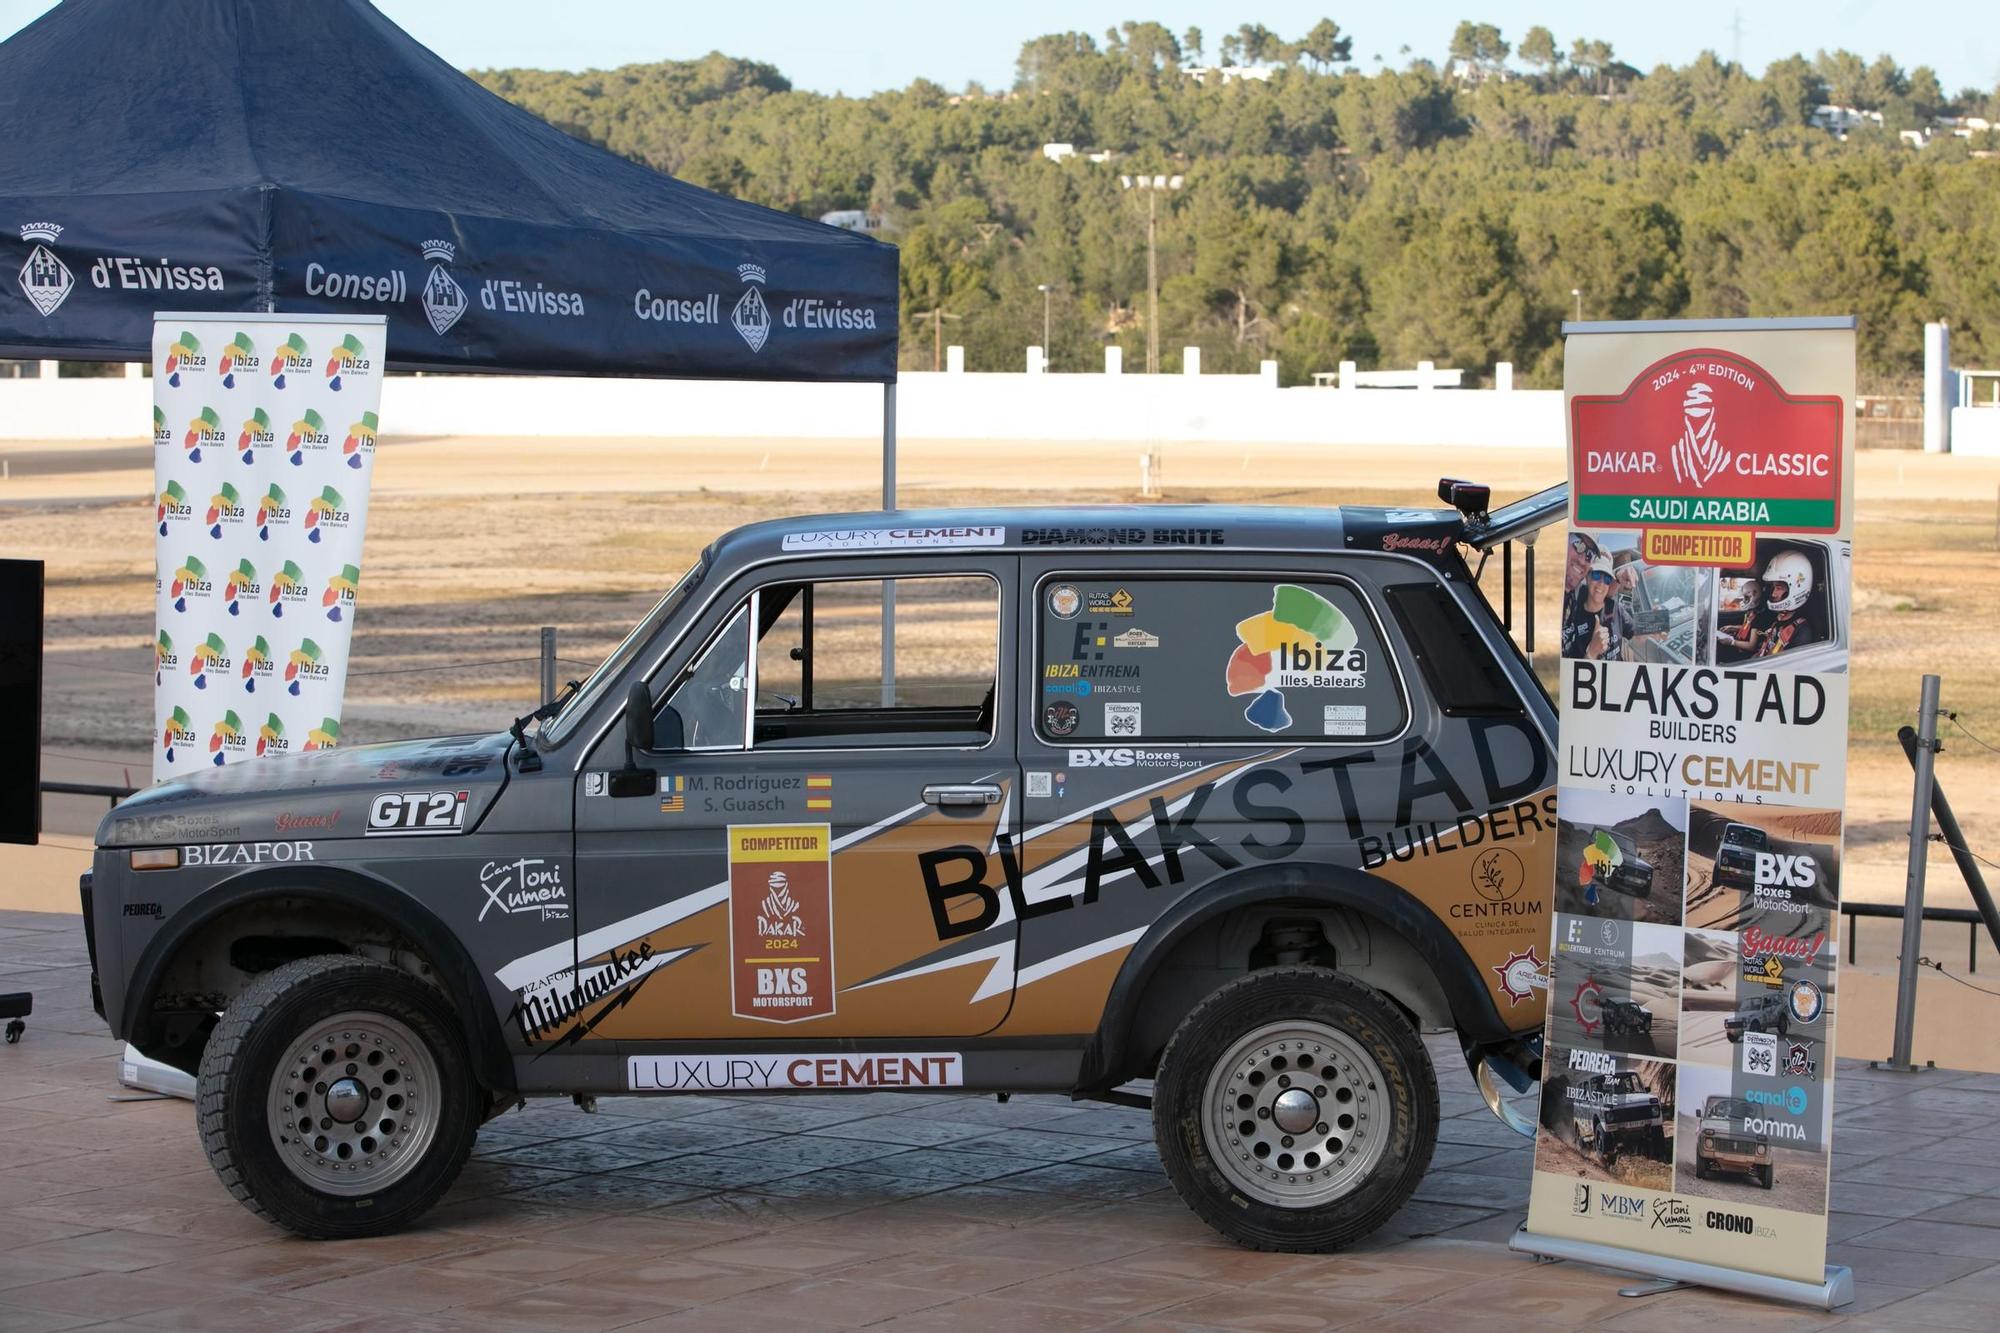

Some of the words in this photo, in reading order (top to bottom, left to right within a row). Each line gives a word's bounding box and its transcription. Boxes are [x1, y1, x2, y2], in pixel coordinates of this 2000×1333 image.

[91, 257, 224, 291] d'Eivissa
[305, 262, 407, 303] Consell
[481, 279, 584, 316] d'Eivissa
[634, 288, 719, 324] Consell
[783, 298, 876, 330] d'Eivissa
[179, 353, 206, 366] Ibiza
[234, 354, 259, 366] Ibiza
[286, 355, 312, 367] Ibiza
[342, 357, 370, 369] Ibiza
[1652, 370, 1680, 391] 2024
[1709, 364, 1755, 391] EDITION
[154, 429, 170, 439] biza
[201, 429, 225, 441] Ibiza
[253, 430, 274, 442] Ibiza
[303, 431, 329, 444] Ibiza
[1587, 451, 1657, 473] DAKAR
[1736, 452, 1829, 476] CLASSIC
[167, 502, 191, 514] Ibiza
[221, 504, 245, 517] Ibiza
[268, 506, 291, 518] Ibiza
[321, 508, 349, 521] Ibiza
[1629, 499, 1687, 519] SAUDI
[1692, 501, 1770, 522] ARABIA
[787, 531, 884, 544] LUXURY
[889, 527, 1001, 538] CEMENT
[827, 539, 954, 547] SOLUTIONS
[1022, 528, 1146, 545] DIAMOND
[1153, 529, 1224, 545] BRITE
[1652, 534, 1742, 558] COMPETITOR
[185, 579, 212, 591] Ibiza
[239, 581, 260, 593] Ibiza
[282, 583, 308, 596] Ibiza
[206, 655, 230, 667] Ibiza
[255, 658, 274, 671] Ibiza
[1280, 641, 1366, 672] Ibiza
[300, 661, 329, 674] Ibiza
[1280, 675, 1308, 686] Illes
[1314, 675, 1365, 687] Balears
[1572, 661, 1826, 726] BLAKSTAD
[173, 729, 195, 741] Ibiza
[224, 732, 246, 745] Ibiza
[1650, 720, 1737, 744] BUILDERS
[267, 736, 288, 749] Ibiza
[1069, 749, 1136, 767] BXS
[1136, 750, 1180, 760] Boxes
[1136, 759, 1202, 769] MotorSport
[1569, 745, 1677, 785] LUXURY
[1682, 754, 1820, 794] CEMENT
[688, 777, 709, 791] M.
[714, 775, 800, 793] Rodríguez
[1610, 784, 1762, 805] SOLUTIONS
[369, 791, 469, 828] GT2i
[704, 799, 718, 812] S.
[723, 797, 785, 811] Guasch
[178, 826, 241, 841] MotorSport
[918, 720, 1549, 942] BLAKSTAD
[741, 837, 818, 851] COMPETITOR
[184, 841, 314, 866] BIZAFOR
[480, 861, 513, 882] Can
[512, 858, 561, 889] Toni
[1754, 852, 1816, 888] BXS
[1754, 884, 1791, 898] Boxes
[479, 877, 566, 922] Xumeu
[1753, 897, 1809, 914] MotorSport
[1450, 901, 1542, 918] CENTRUM
[757, 915, 805, 936] DAKAR
[1458, 929, 1484, 937] SALUD
[1487, 927, 1536, 936] INTEGRATIVA
[765, 939, 798, 949] 2024
[1594, 947, 1625, 958] CENTRUM
[517, 968, 574, 997] BIZAFOR
[758, 968, 807, 995] BXS
[515, 941, 656, 1047] Milwaukee
[753, 996, 813, 1007] MOTORSPORT
[1569, 1049, 1616, 1075] PEDREGA
[633, 1059, 778, 1090] LUXURY
[786, 1056, 956, 1087] CEMENT
[1601, 1194, 1646, 1217] MBM
[1668, 1198, 1689, 1216] Toni
[1706, 1210, 1754, 1235] CRONO
